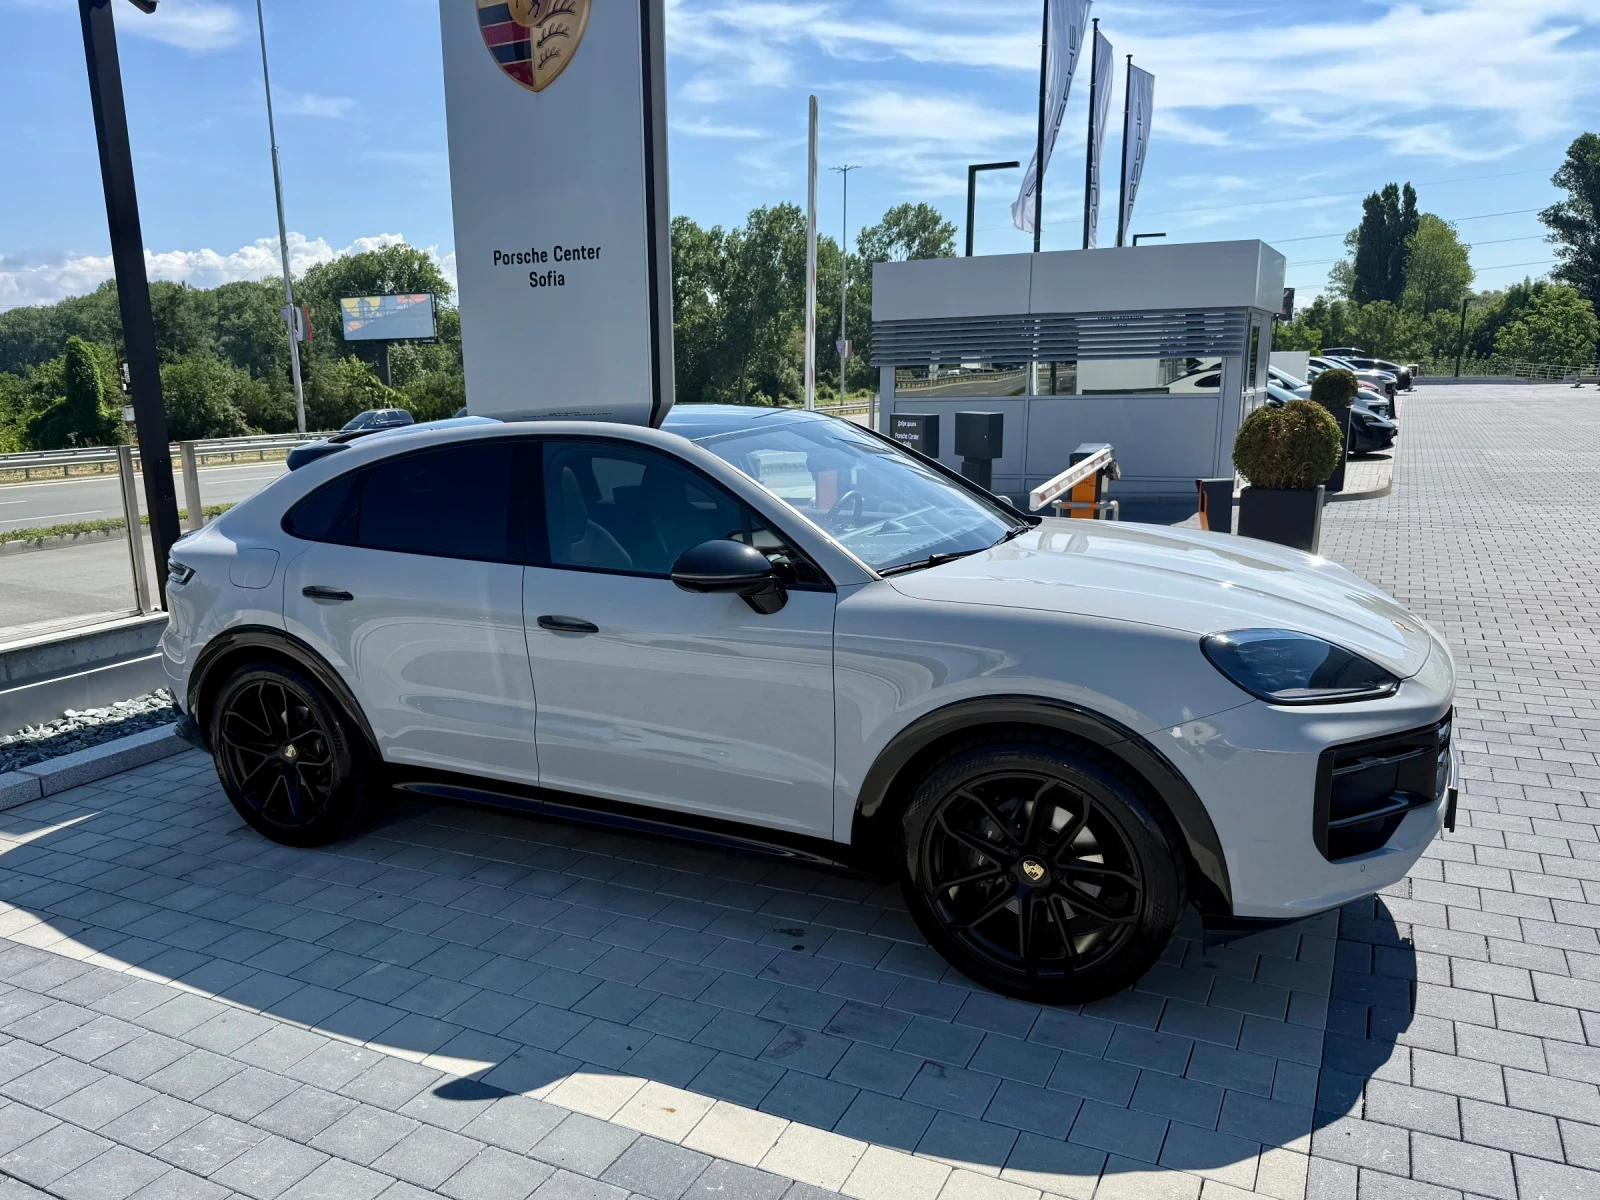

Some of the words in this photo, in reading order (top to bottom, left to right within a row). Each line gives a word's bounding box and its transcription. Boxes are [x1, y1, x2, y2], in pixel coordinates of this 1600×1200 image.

[493, 247, 548, 266] Porsche
[553, 245, 601, 262] Center
[529, 270, 565, 288] Sofia
